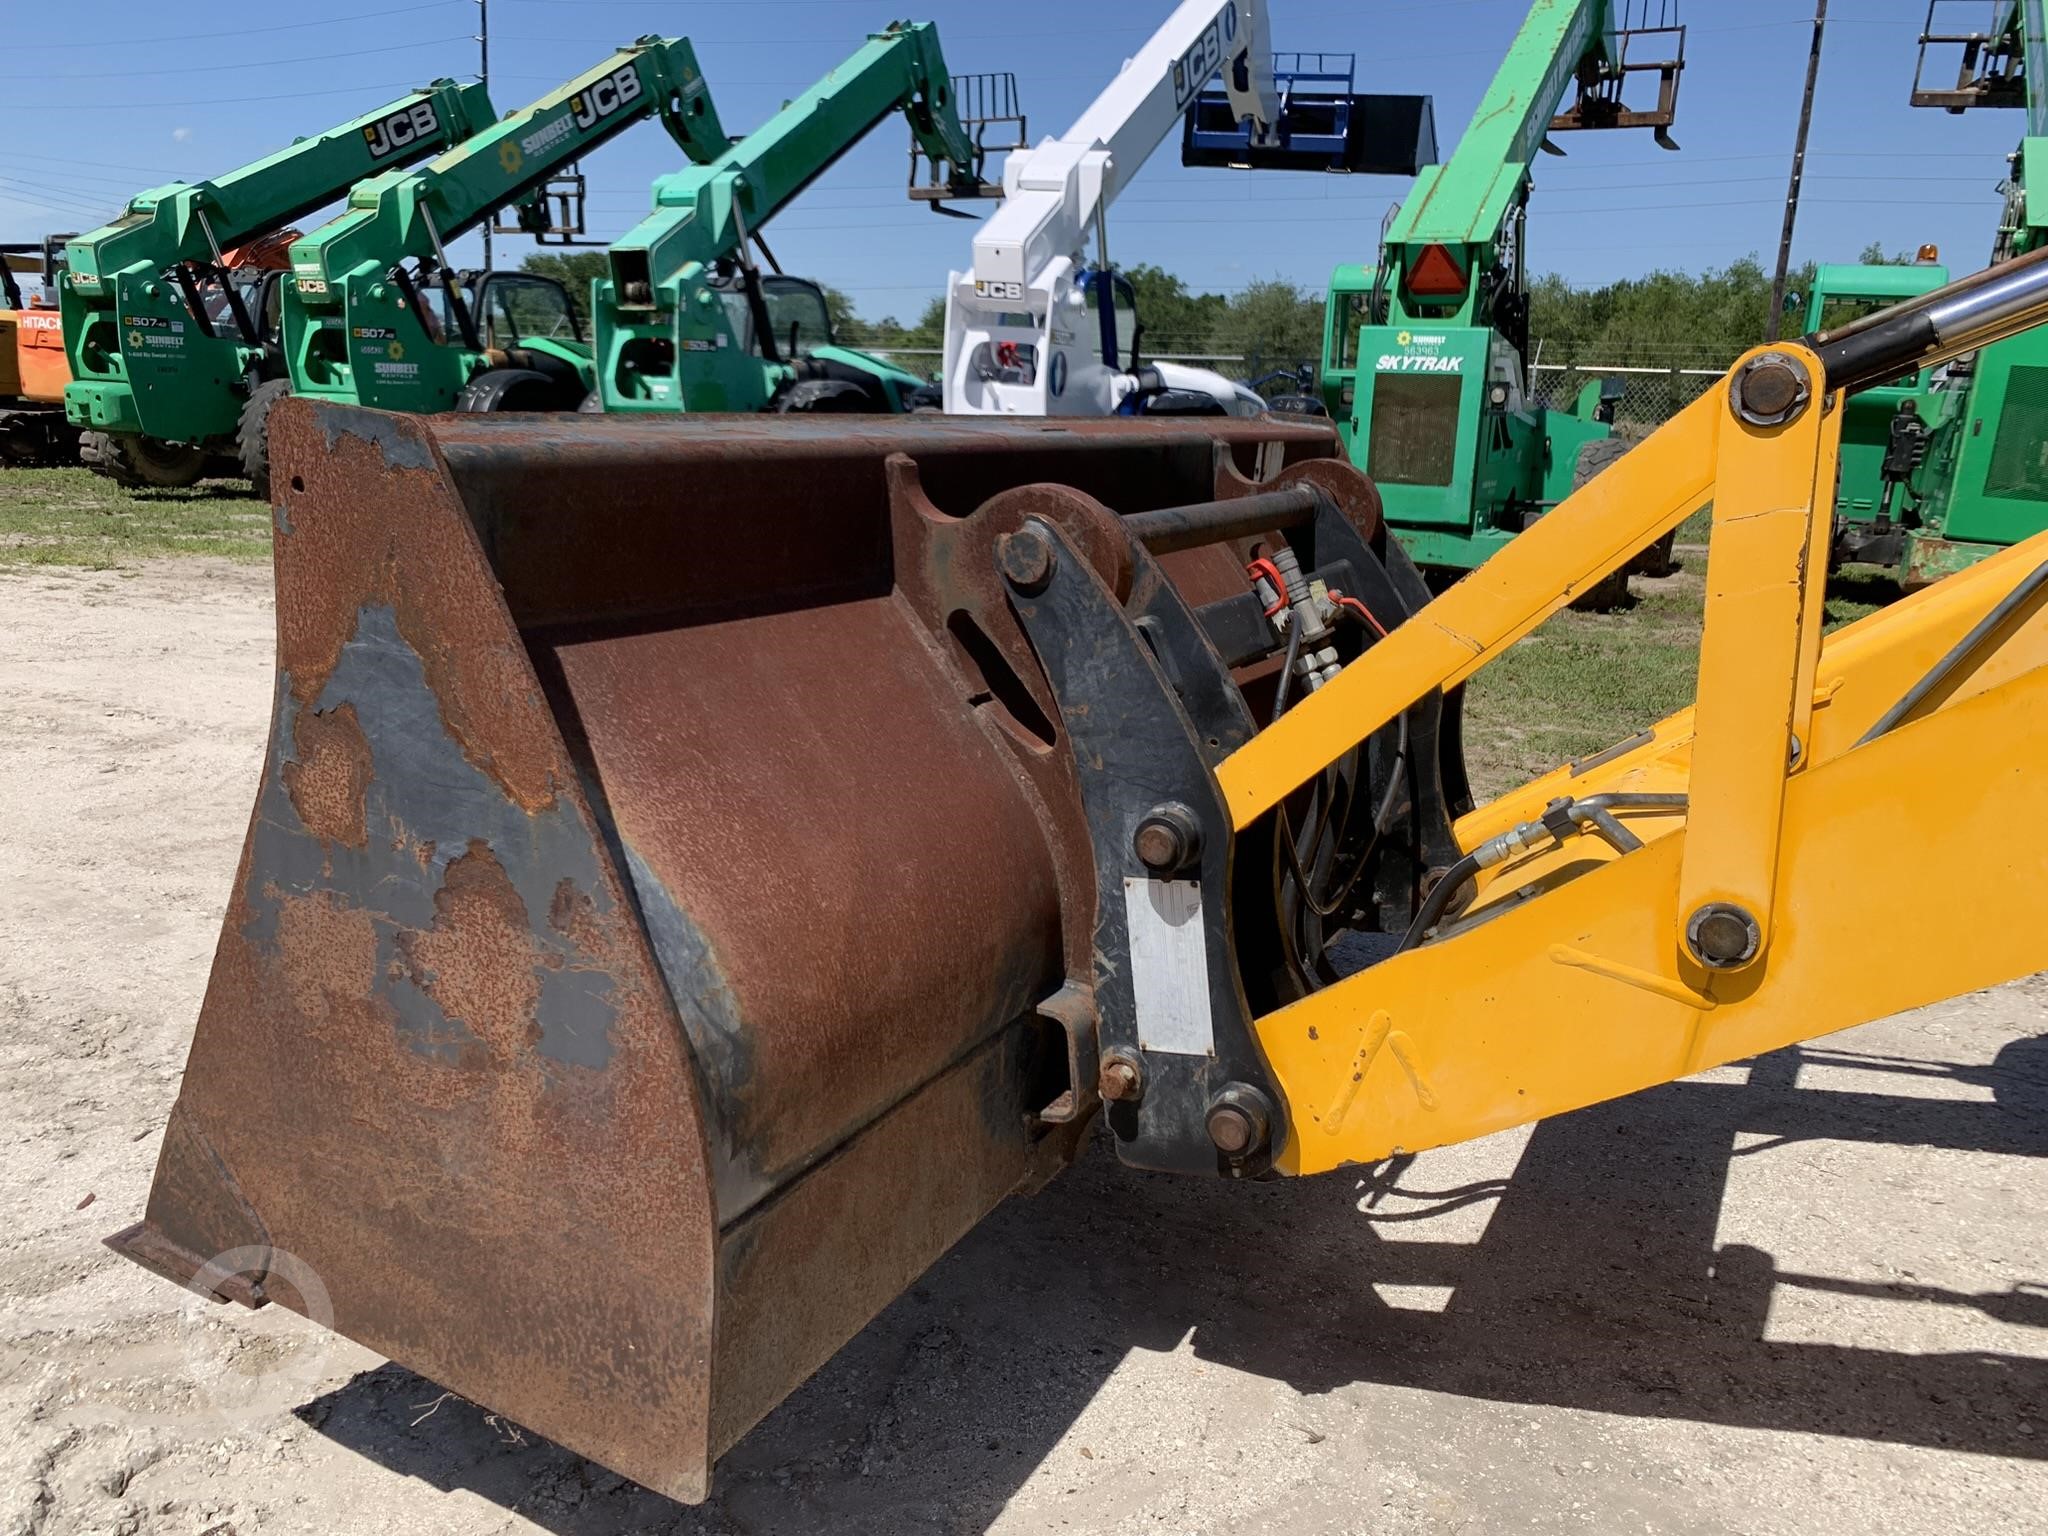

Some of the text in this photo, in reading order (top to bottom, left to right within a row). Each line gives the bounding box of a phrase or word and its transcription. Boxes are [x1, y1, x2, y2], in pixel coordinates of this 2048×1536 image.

[1176, 25, 1220, 105] JCB
[575, 64, 642, 129] JCB
[369, 102, 438, 156] JCB
[521, 112, 575, 155] SUNBELT
[71, 272, 99, 284] JCB
[298, 279, 328, 293] JCB
[975, 280, 1022, 299] JCB
[145, 335, 184, 346] SUNBELT
[1404, 345, 1440, 356] 563963
[374, 362, 419, 374] SUNBELT
[1375, 354, 1464, 371] SKYTRAK
